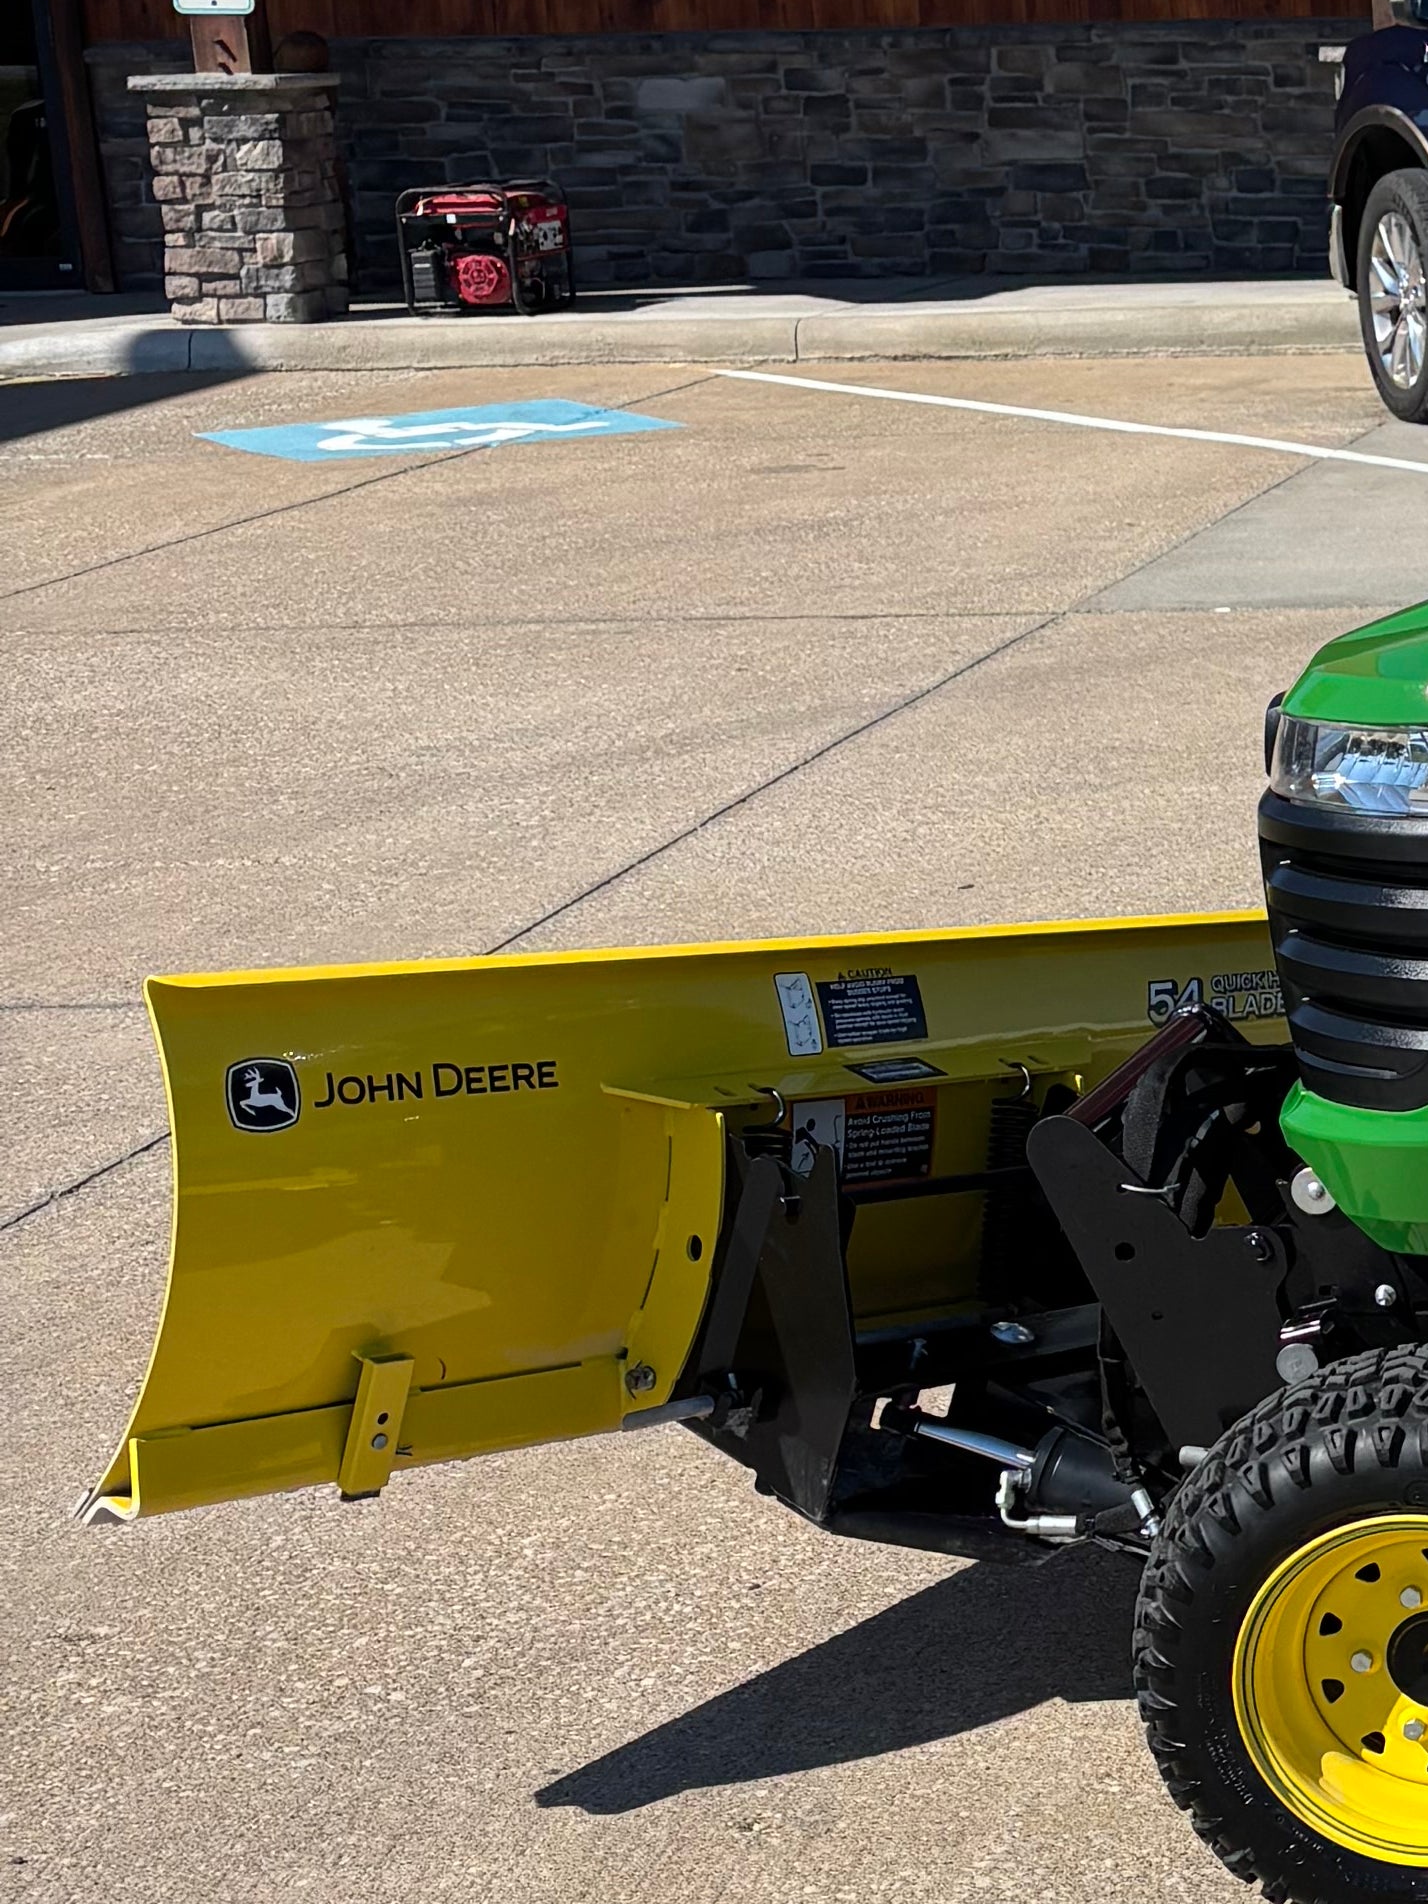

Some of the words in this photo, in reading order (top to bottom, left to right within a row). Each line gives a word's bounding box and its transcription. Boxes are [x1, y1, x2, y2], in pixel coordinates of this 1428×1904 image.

[847, 967, 893, 979] CAUTION
[1148, 978, 1203, 1027] 54
[1212, 972, 1264, 992] QUICK
[314, 1071, 424, 1108] JOHN
[431, 1060, 560, 1097] DEERE
[847, 1115, 871, 1126] Avoid
[872, 1111, 909, 1124] Crushing
[910, 1110, 931, 1120] From
